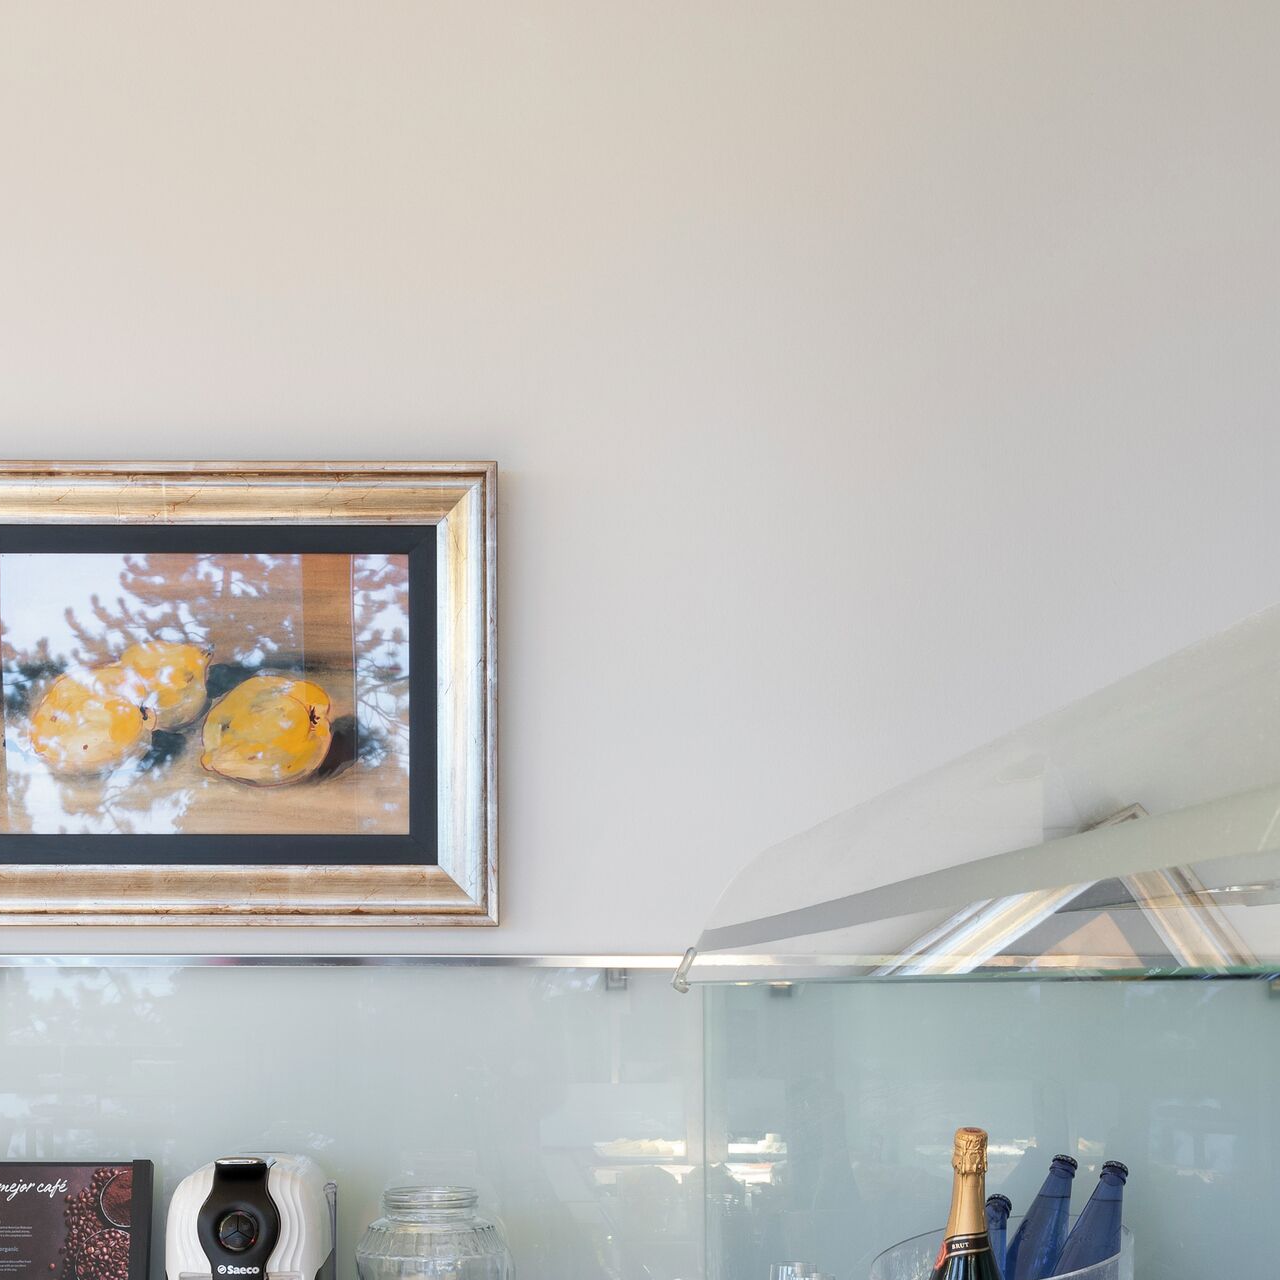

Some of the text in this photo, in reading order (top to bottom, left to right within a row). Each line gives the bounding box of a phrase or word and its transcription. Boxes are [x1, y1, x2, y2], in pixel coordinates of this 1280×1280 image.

[36, 1178, 68, 1198] café
[952, 1242, 969, 1250] BRUT
[227, 1265, 260, 1274] Saeco
